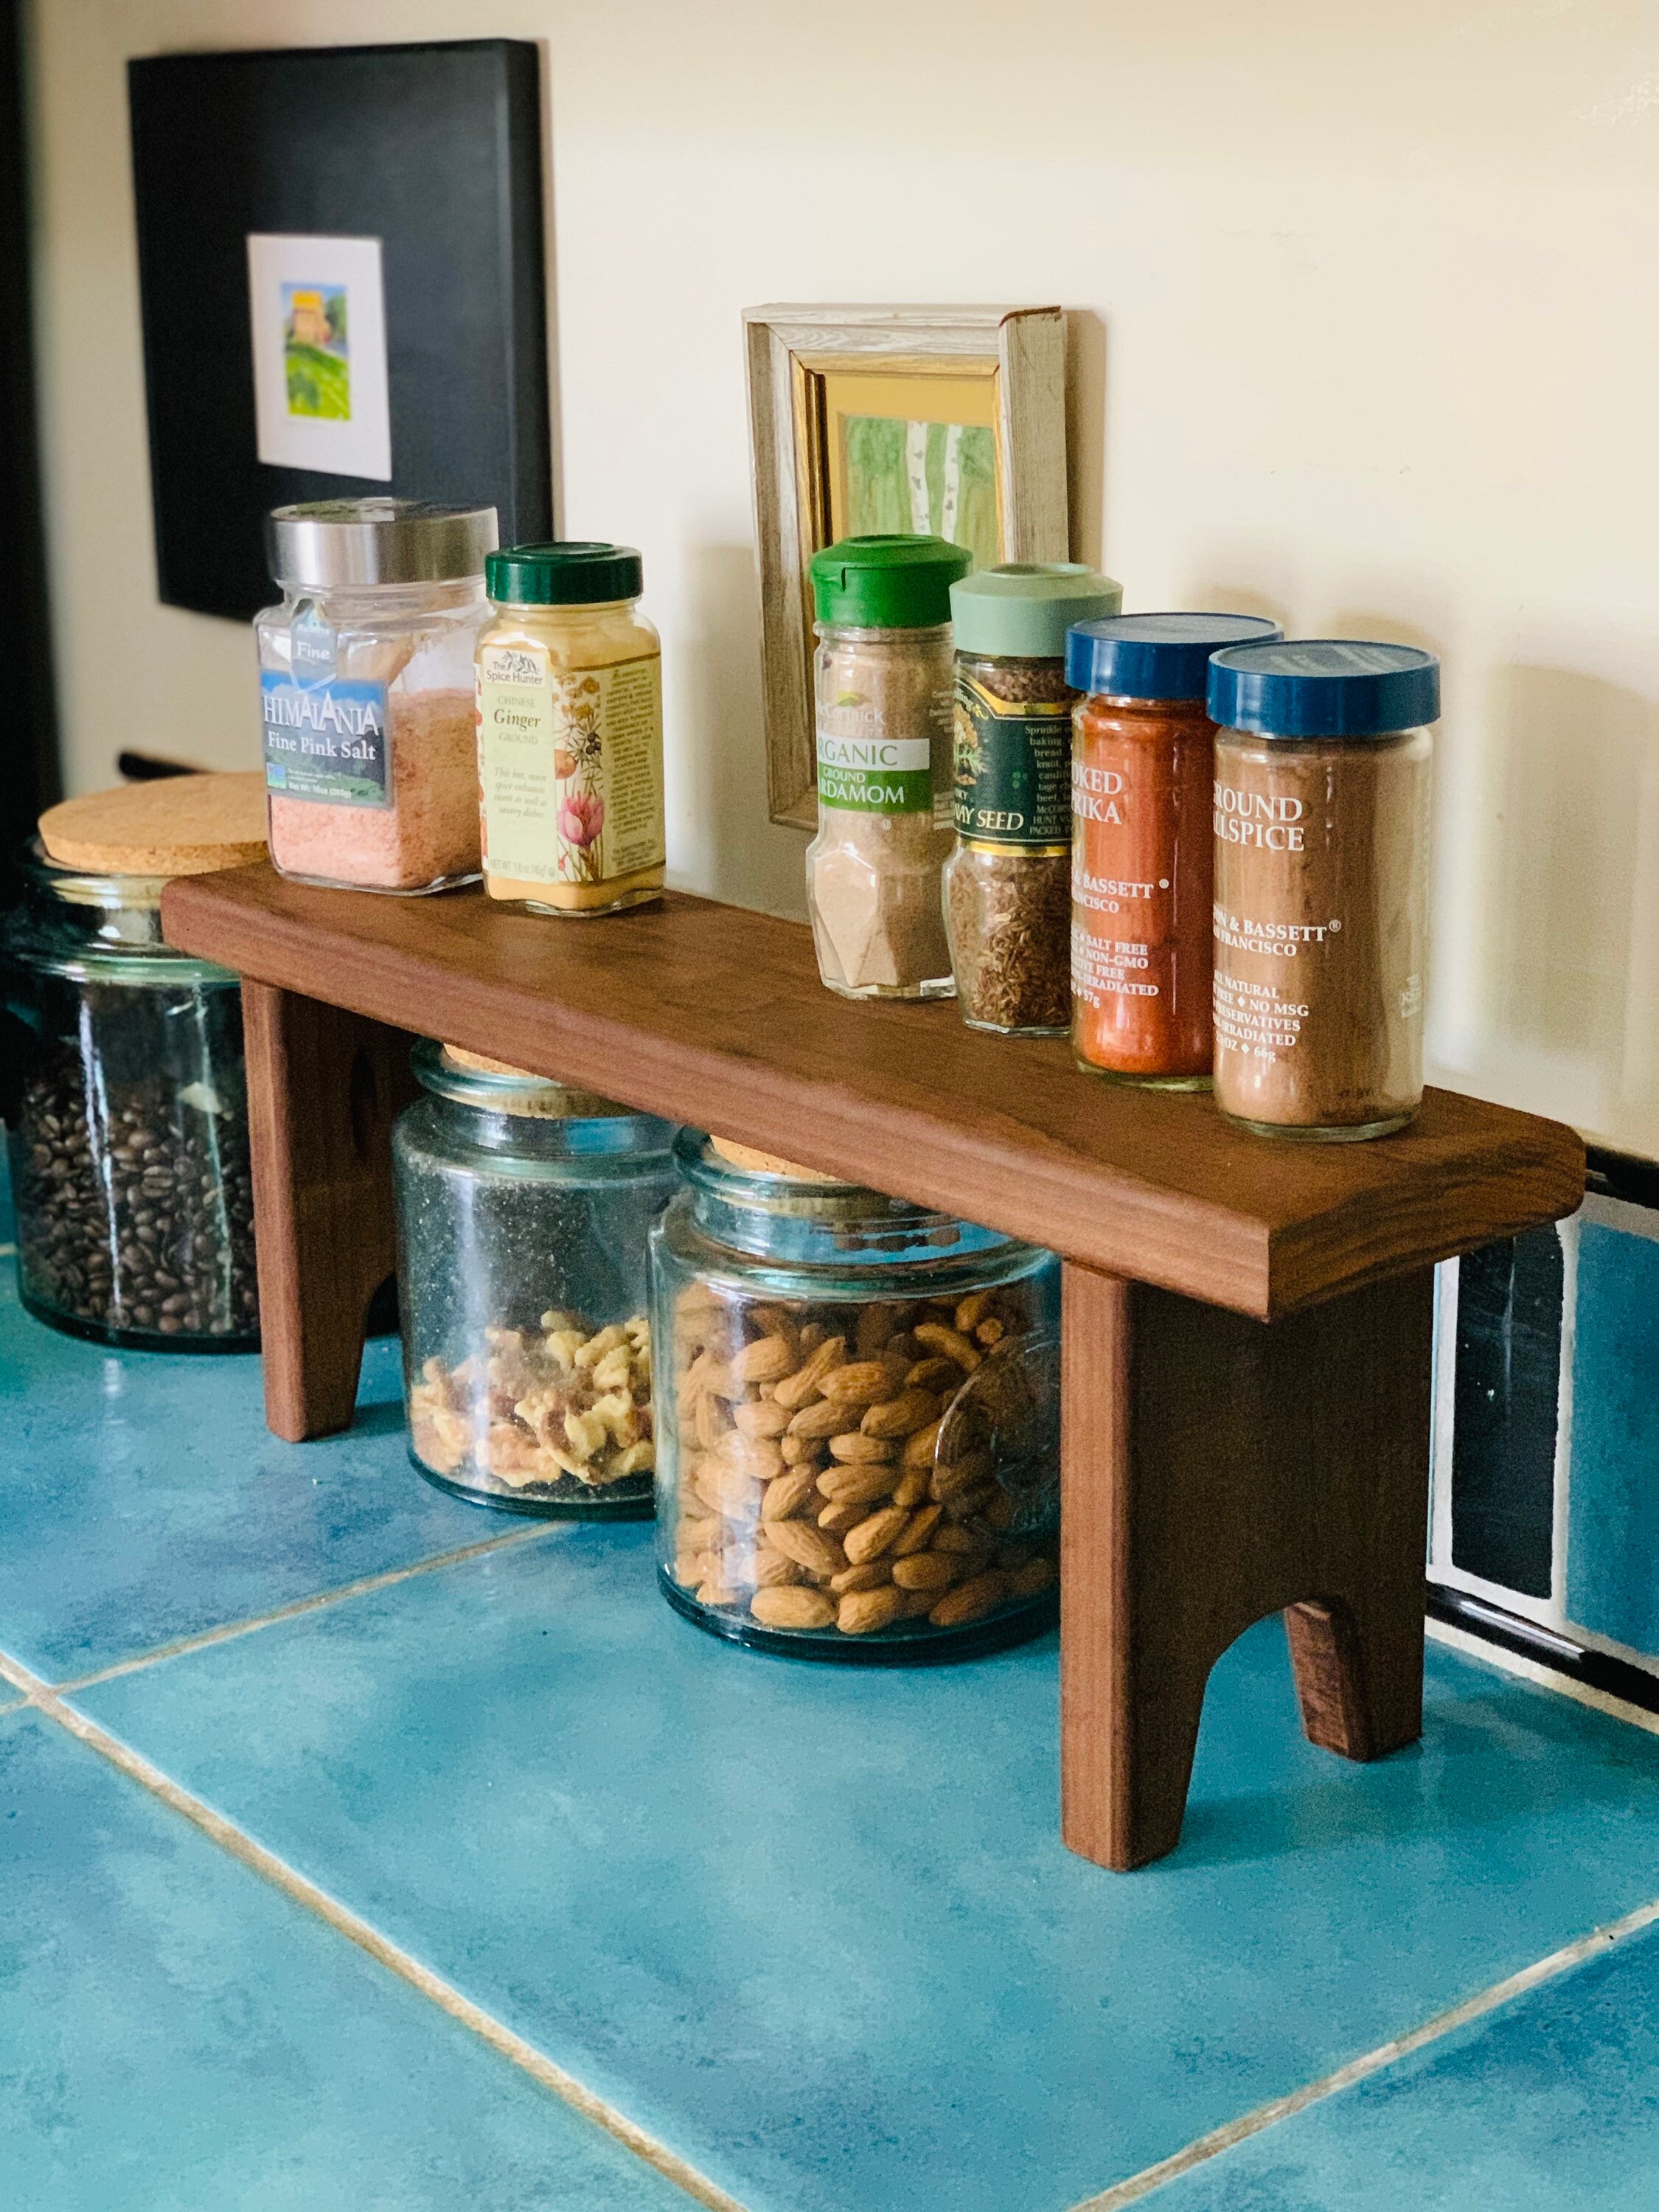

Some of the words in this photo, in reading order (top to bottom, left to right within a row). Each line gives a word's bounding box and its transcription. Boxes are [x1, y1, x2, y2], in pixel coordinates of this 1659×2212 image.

[296, 641, 330, 660] Fine
[493, 661, 506, 670] The
[487, 670, 511, 682] Spice
[512, 672, 543, 684] Hunter
[498, 696, 535, 708] CHINESE
[262, 689, 379, 737] HIMALANIA
[494, 709, 541, 731] Ginger
[819, 703, 886, 725] cCormick
[499, 732, 538, 745] GROUND
[1025, 725, 1062, 736] Sprinkle
[268, 731, 296, 751] Fine
[300, 737, 337, 757] Pink
[341, 740, 376, 760] Salt
[818, 737, 897, 765] RGANIC
[1034, 748, 1062, 757] bread
[823, 767, 866, 783] GROUND
[1071, 762, 1122, 795] OKED
[820, 777, 905, 803] RDAMOM
[1214, 780, 1303, 821] ROUND
[1071, 788, 1122, 825] RIKA
[976, 810, 1024, 831] SEED
[1230, 916, 1239, 932] &
[1086, 934, 1111, 950] SALT
[1115, 942, 1148, 956] FREE
[1221, 930, 1297, 956] FRANCISCO
[1086, 947, 1149, 969] NON-GMO
[1096, 964, 1125, 981] FREE
[1225, 976, 1279, 998] NATURAL
[1083, 990, 1100, 1009] 57g
[1249, 999, 1270, 1012] NO
[1274, 1003, 1310, 1017] MSG
[1254, 1046, 1276, 1063] 66g
